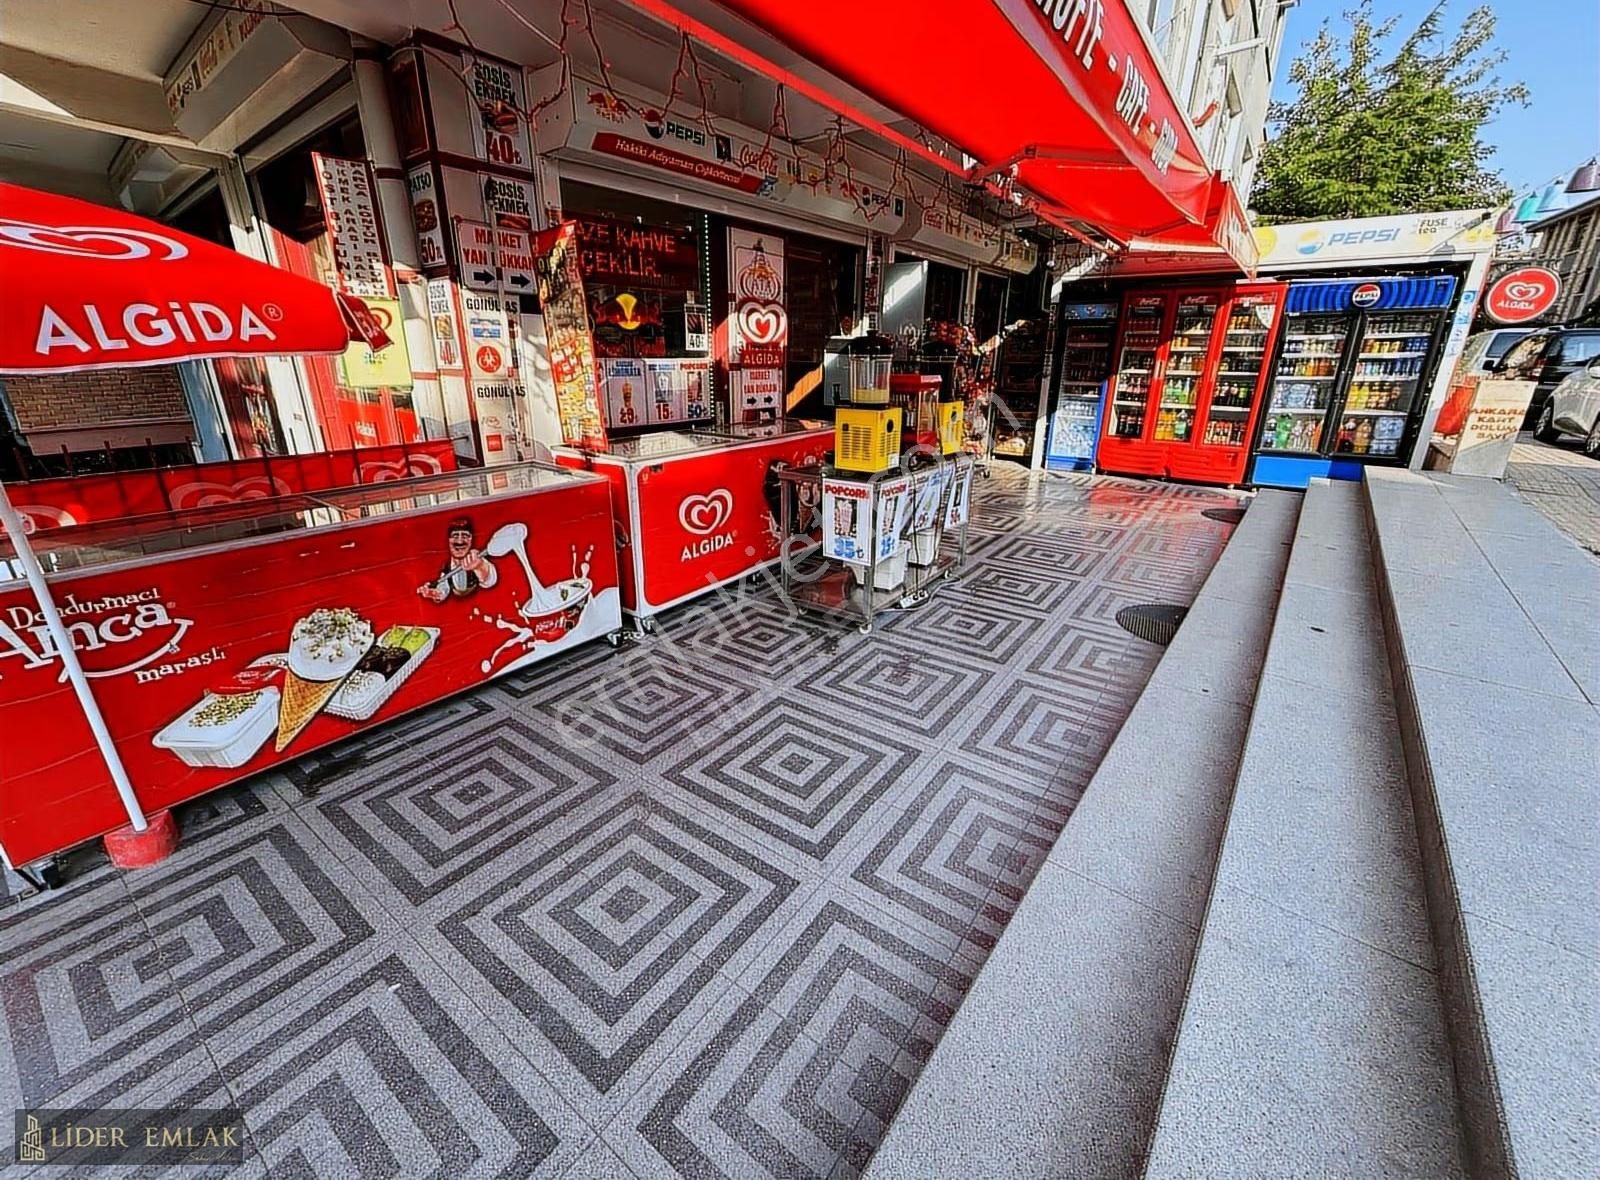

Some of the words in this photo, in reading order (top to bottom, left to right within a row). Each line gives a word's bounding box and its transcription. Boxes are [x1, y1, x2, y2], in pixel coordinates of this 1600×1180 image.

[1116, 55, 1150, 136] CAFE
[666, 122, 706, 147] PEPSI
[1419, 217, 1449, 228] FUSE
[474, 228, 522, 249] MAKET
[616, 226, 677, 254] KAHVE
[1327, 227, 1402, 247] PEPSI
[463, 248, 488, 266] YAN
[824, 484, 871, 499] POPCORN
[0, 603, 172, 669] Amca
